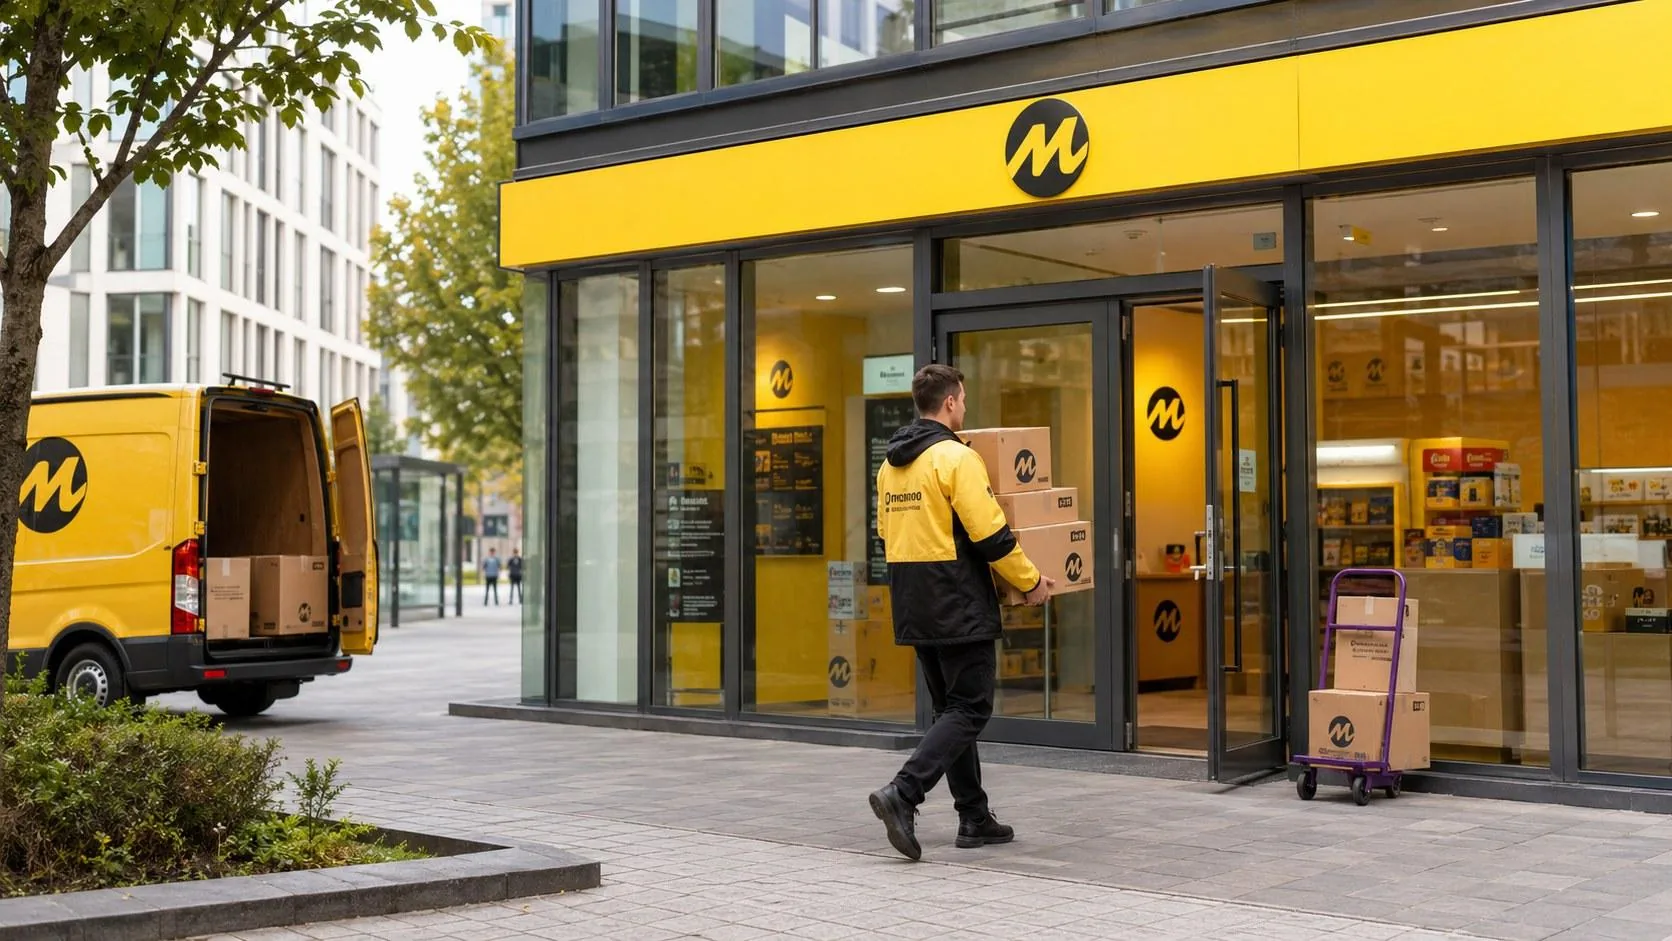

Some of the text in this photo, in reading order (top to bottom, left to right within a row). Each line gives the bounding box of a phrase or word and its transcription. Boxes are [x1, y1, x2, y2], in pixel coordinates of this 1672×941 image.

[1006, 116, 1088, 179] M
[771, 367, 793, 391] M
[1148, 398, 1185, 430] M
[1014, 455, 1036, 476] M
[19, 456, 87, 512] M
[1065, 557, 1082, 576] M
[1155, 607, 1181, 632] M
[829, 662, 851, 682] M
[1329, 722, 1355, 741] M
